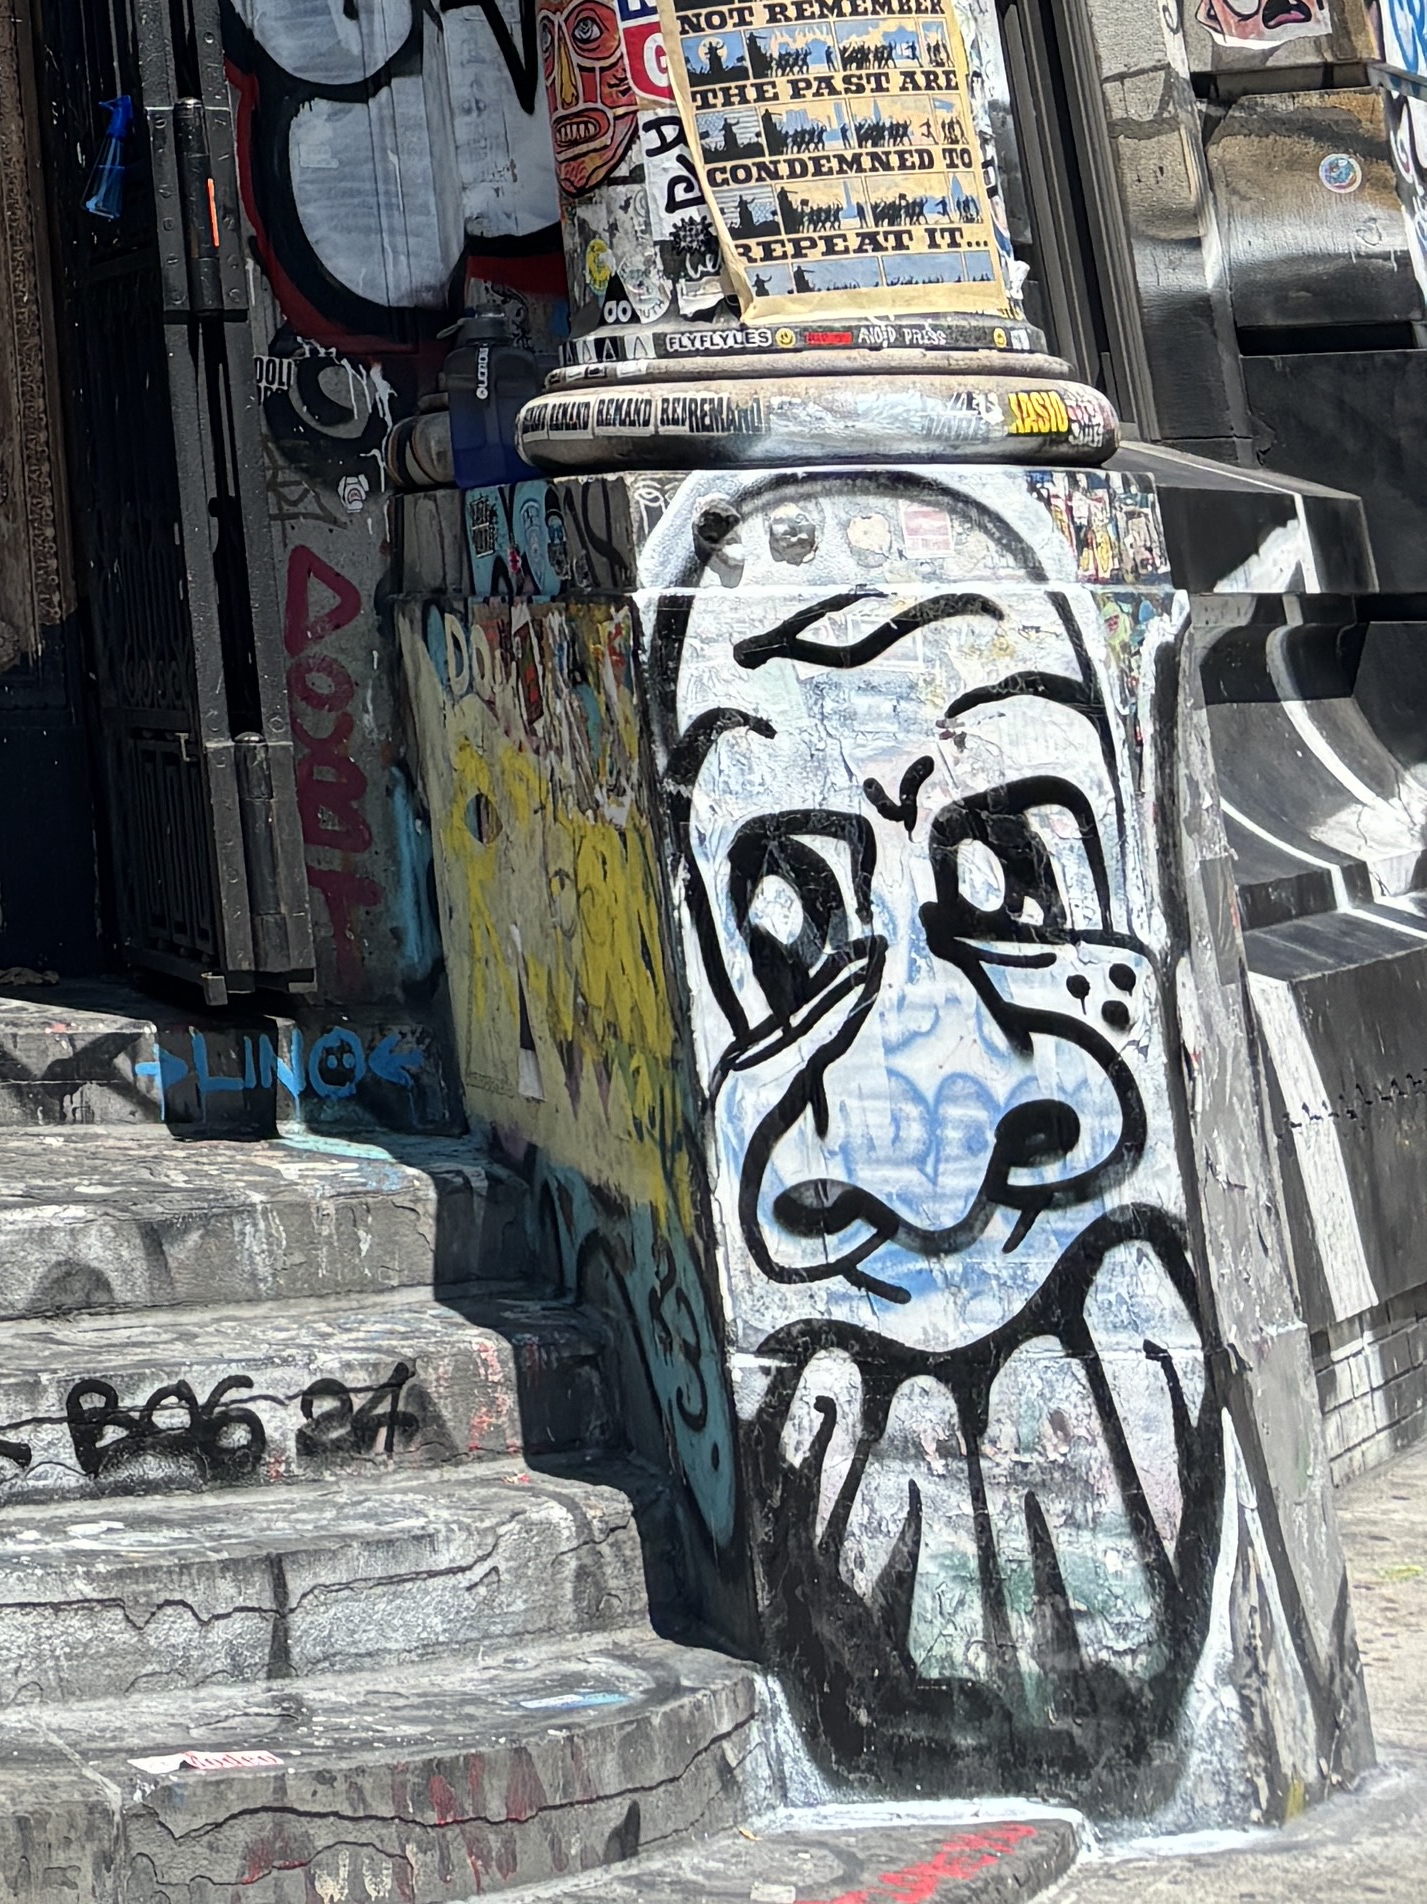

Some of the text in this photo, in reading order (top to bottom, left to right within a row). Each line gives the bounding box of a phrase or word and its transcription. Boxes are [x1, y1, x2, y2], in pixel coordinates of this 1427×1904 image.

[676, 5, 756, 35] NOT
[690, 67, 960, 110] THE PAST ARE
[706, 145, 974, 188] CONDEMNED TO
[735, 226, 989, 265] REPEAT IT...
